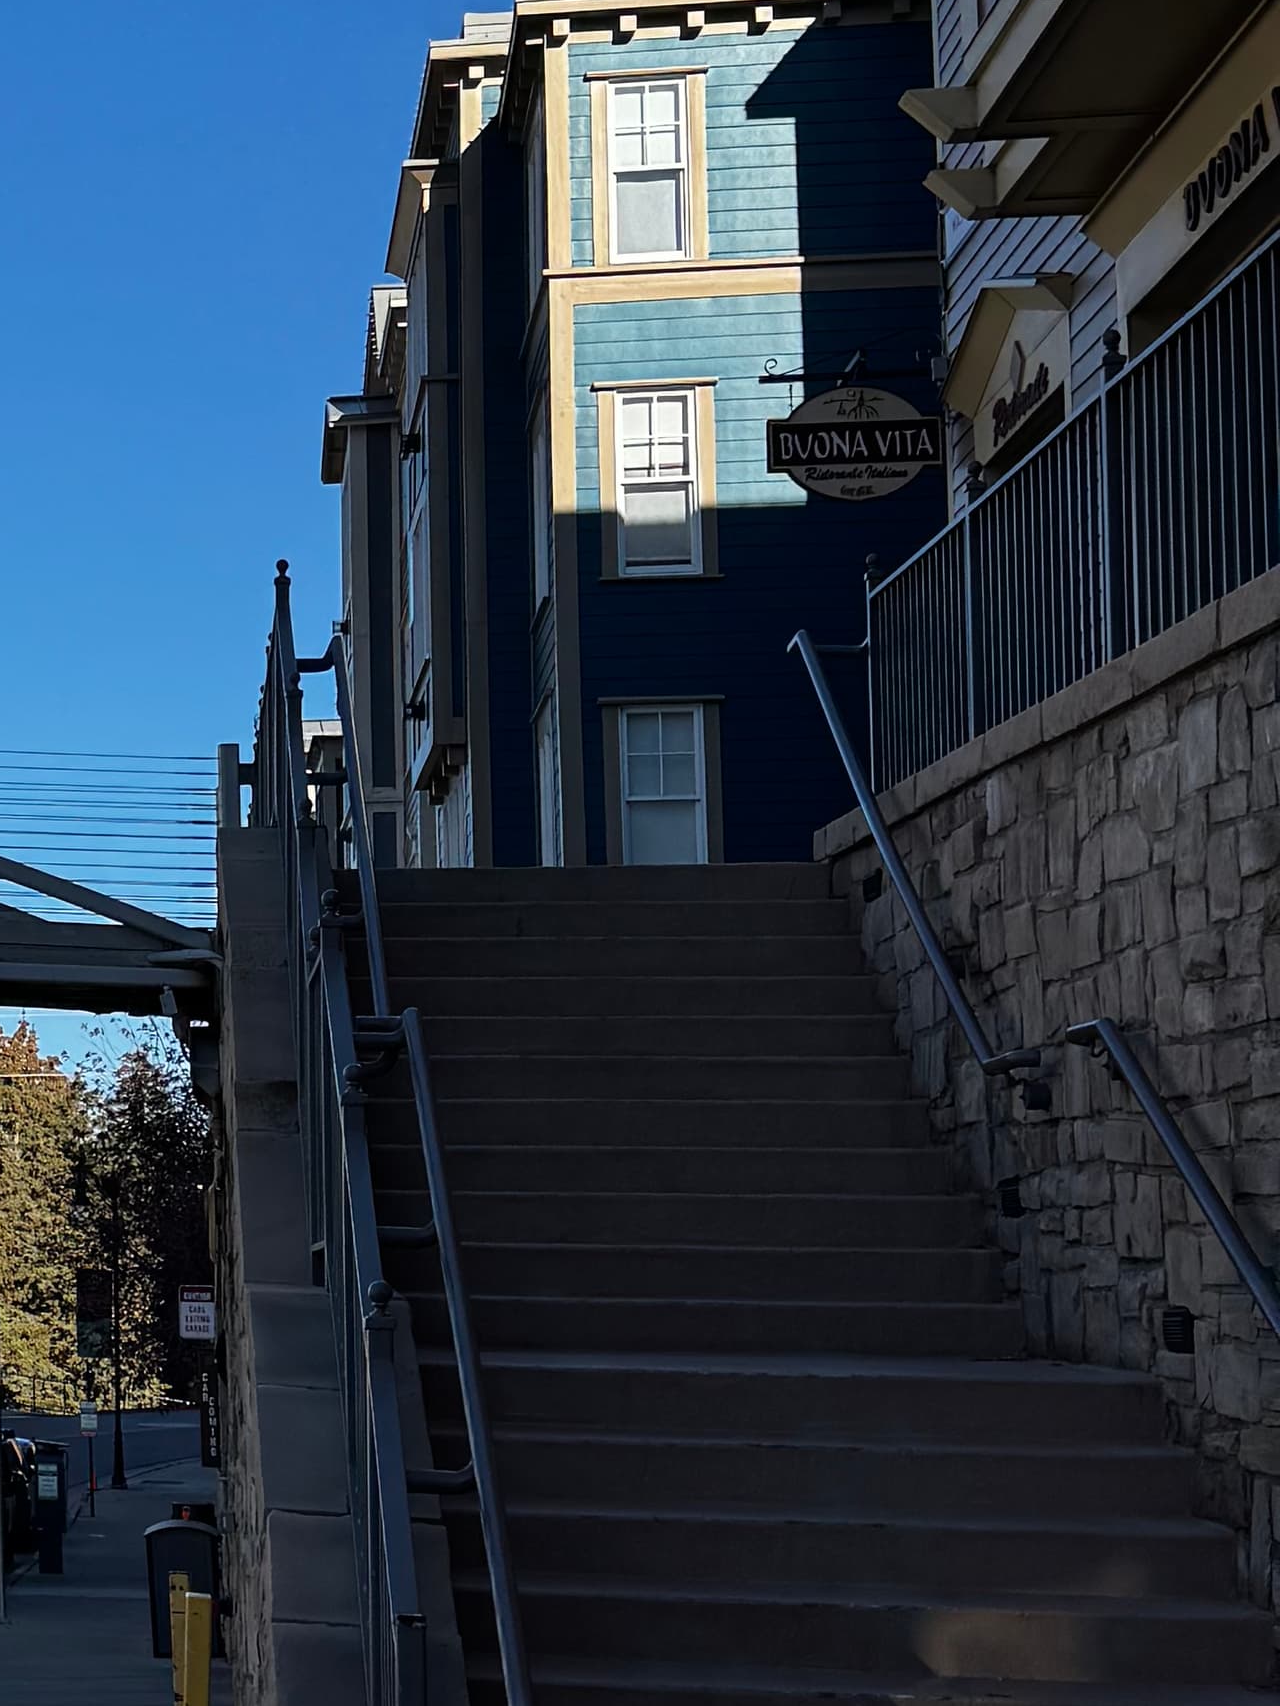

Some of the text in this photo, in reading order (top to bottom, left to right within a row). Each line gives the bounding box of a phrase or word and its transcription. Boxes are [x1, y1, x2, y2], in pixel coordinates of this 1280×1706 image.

[779, 428, 934, 460] BUONA VITA
[804, 467, 863, 482] Ristorante
[208, 1396, 217, 1457] COMING
